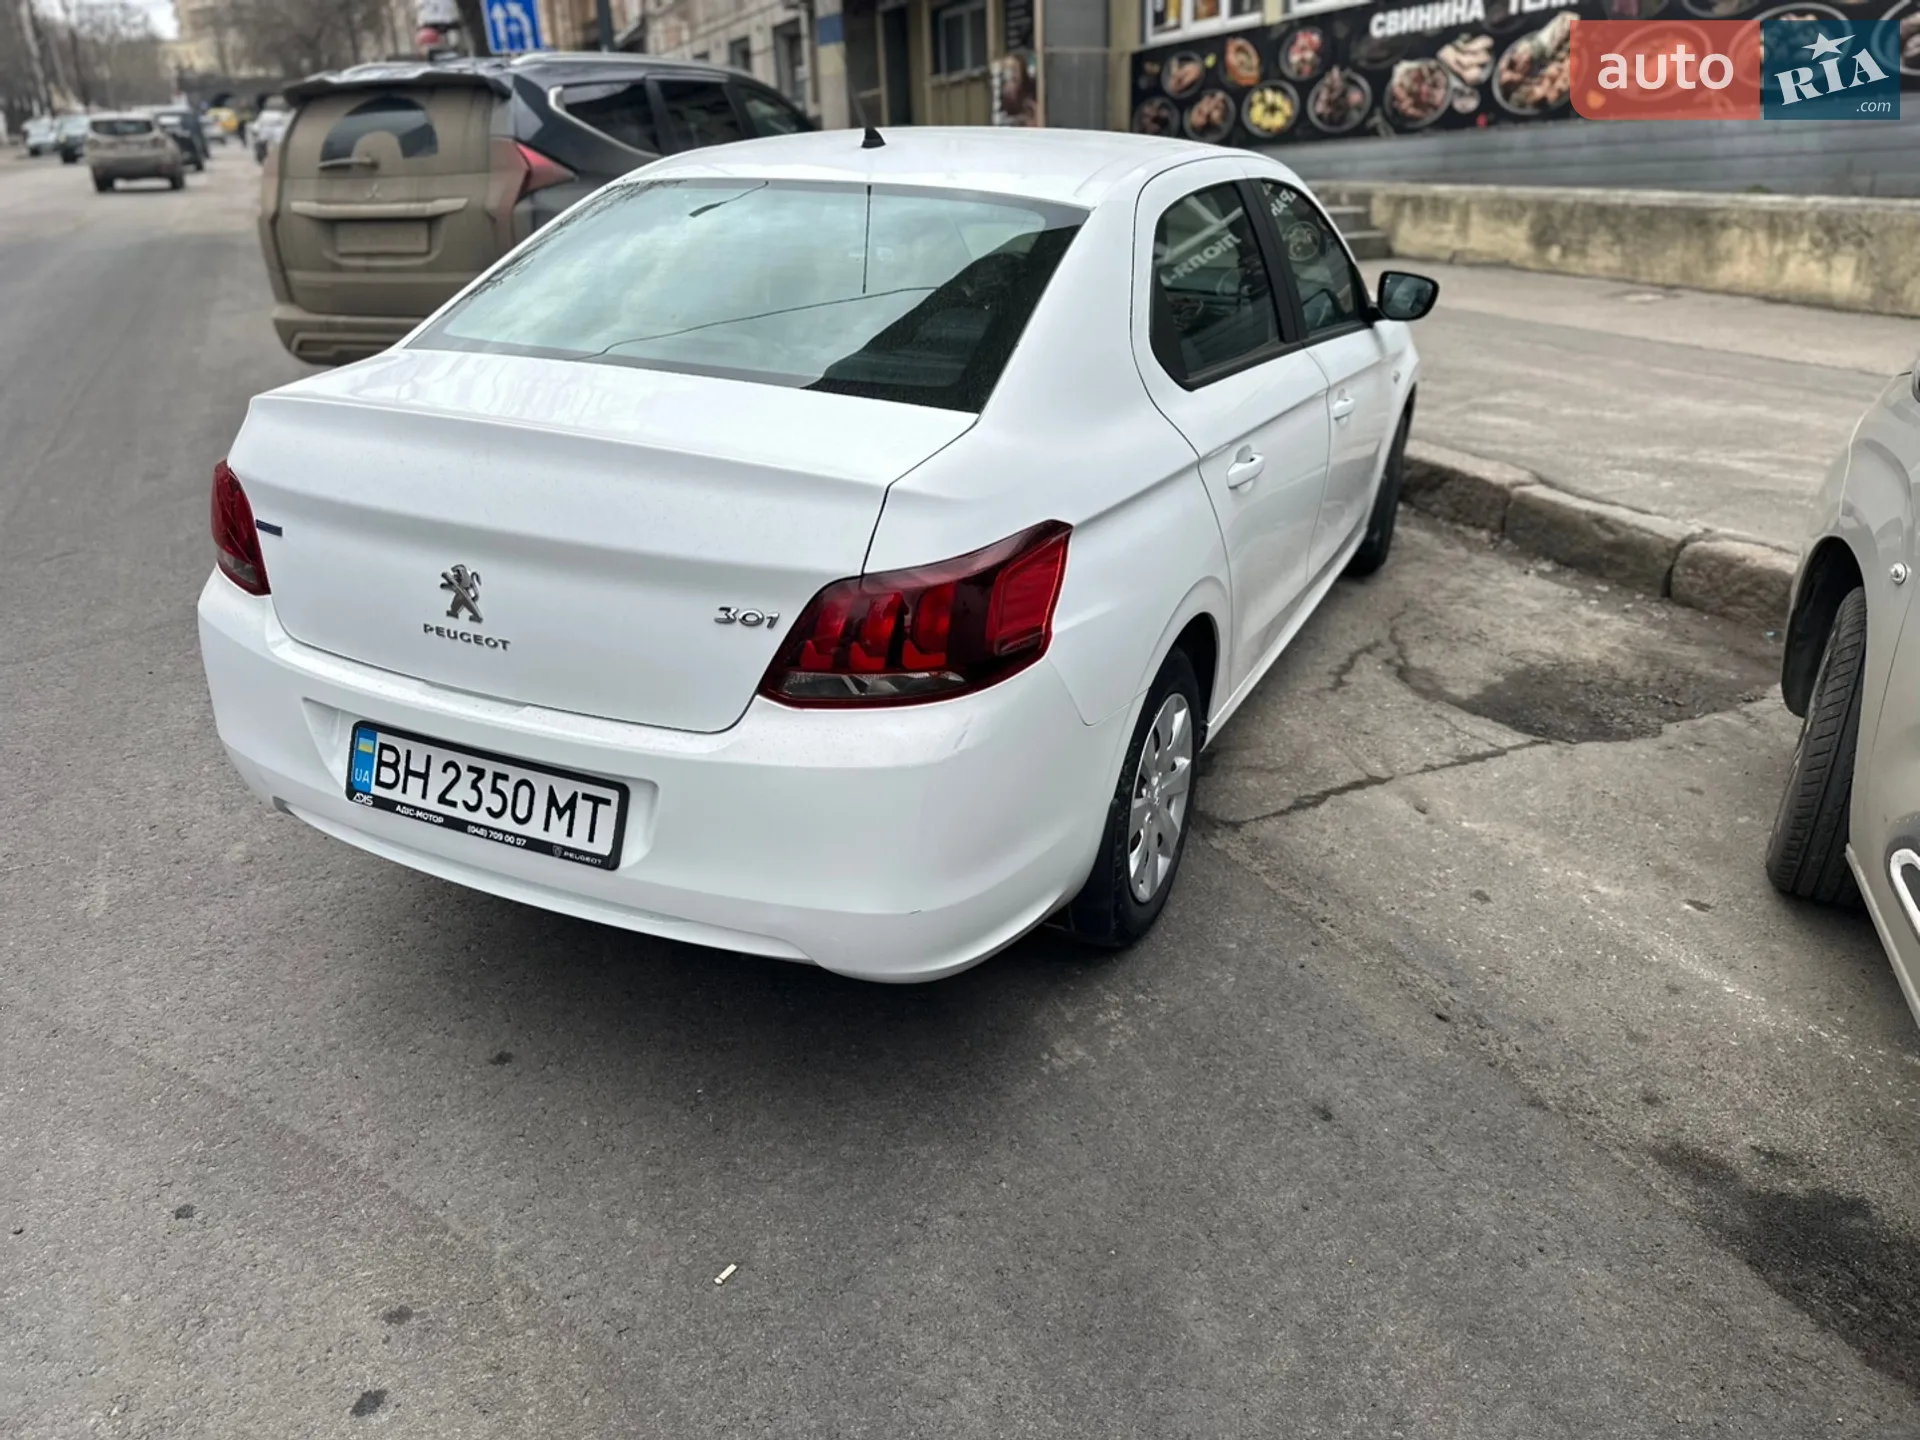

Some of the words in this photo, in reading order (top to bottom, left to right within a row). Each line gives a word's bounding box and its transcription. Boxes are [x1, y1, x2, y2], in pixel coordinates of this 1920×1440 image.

[1369, 0, 1486, 38] СВИНИНА
[714, 606, 780, 630] 301
[423, 623, 511, 652] PEUGEOT
[354, 767, 370, 785] UA
[374, 742, 432, 801] BH
[437, 759, 536, 826] 2350
[543, 784, 612, 844] MT
